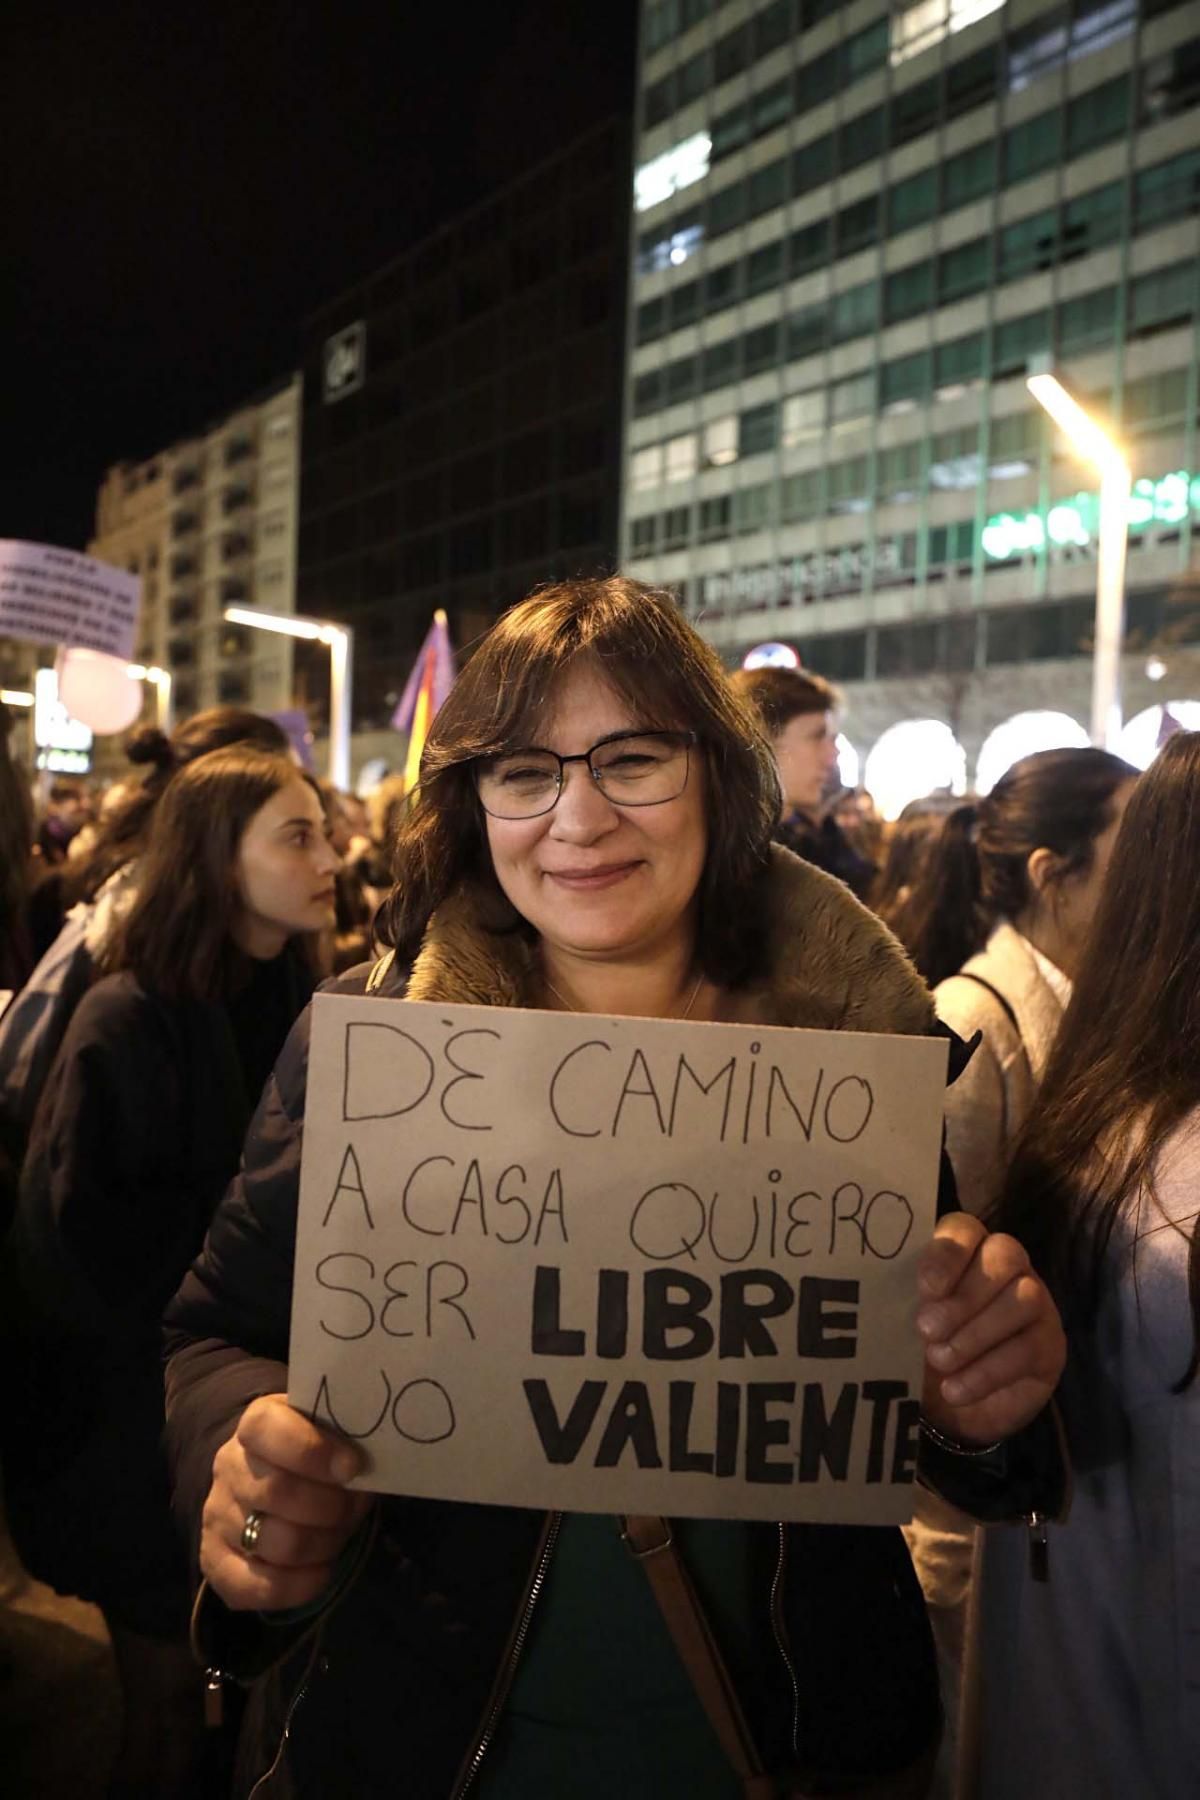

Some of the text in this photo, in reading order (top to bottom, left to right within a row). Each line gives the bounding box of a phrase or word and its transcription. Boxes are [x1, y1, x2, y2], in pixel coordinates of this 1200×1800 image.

[549, 1038, 874, 1145] CAMINO
[322, 1143, 914, 1262] A CASA QUIERO
[315, 1252, 861, 1361] SER LIBRE
[311, 1370, 921, 1486] NO VALIENTE
